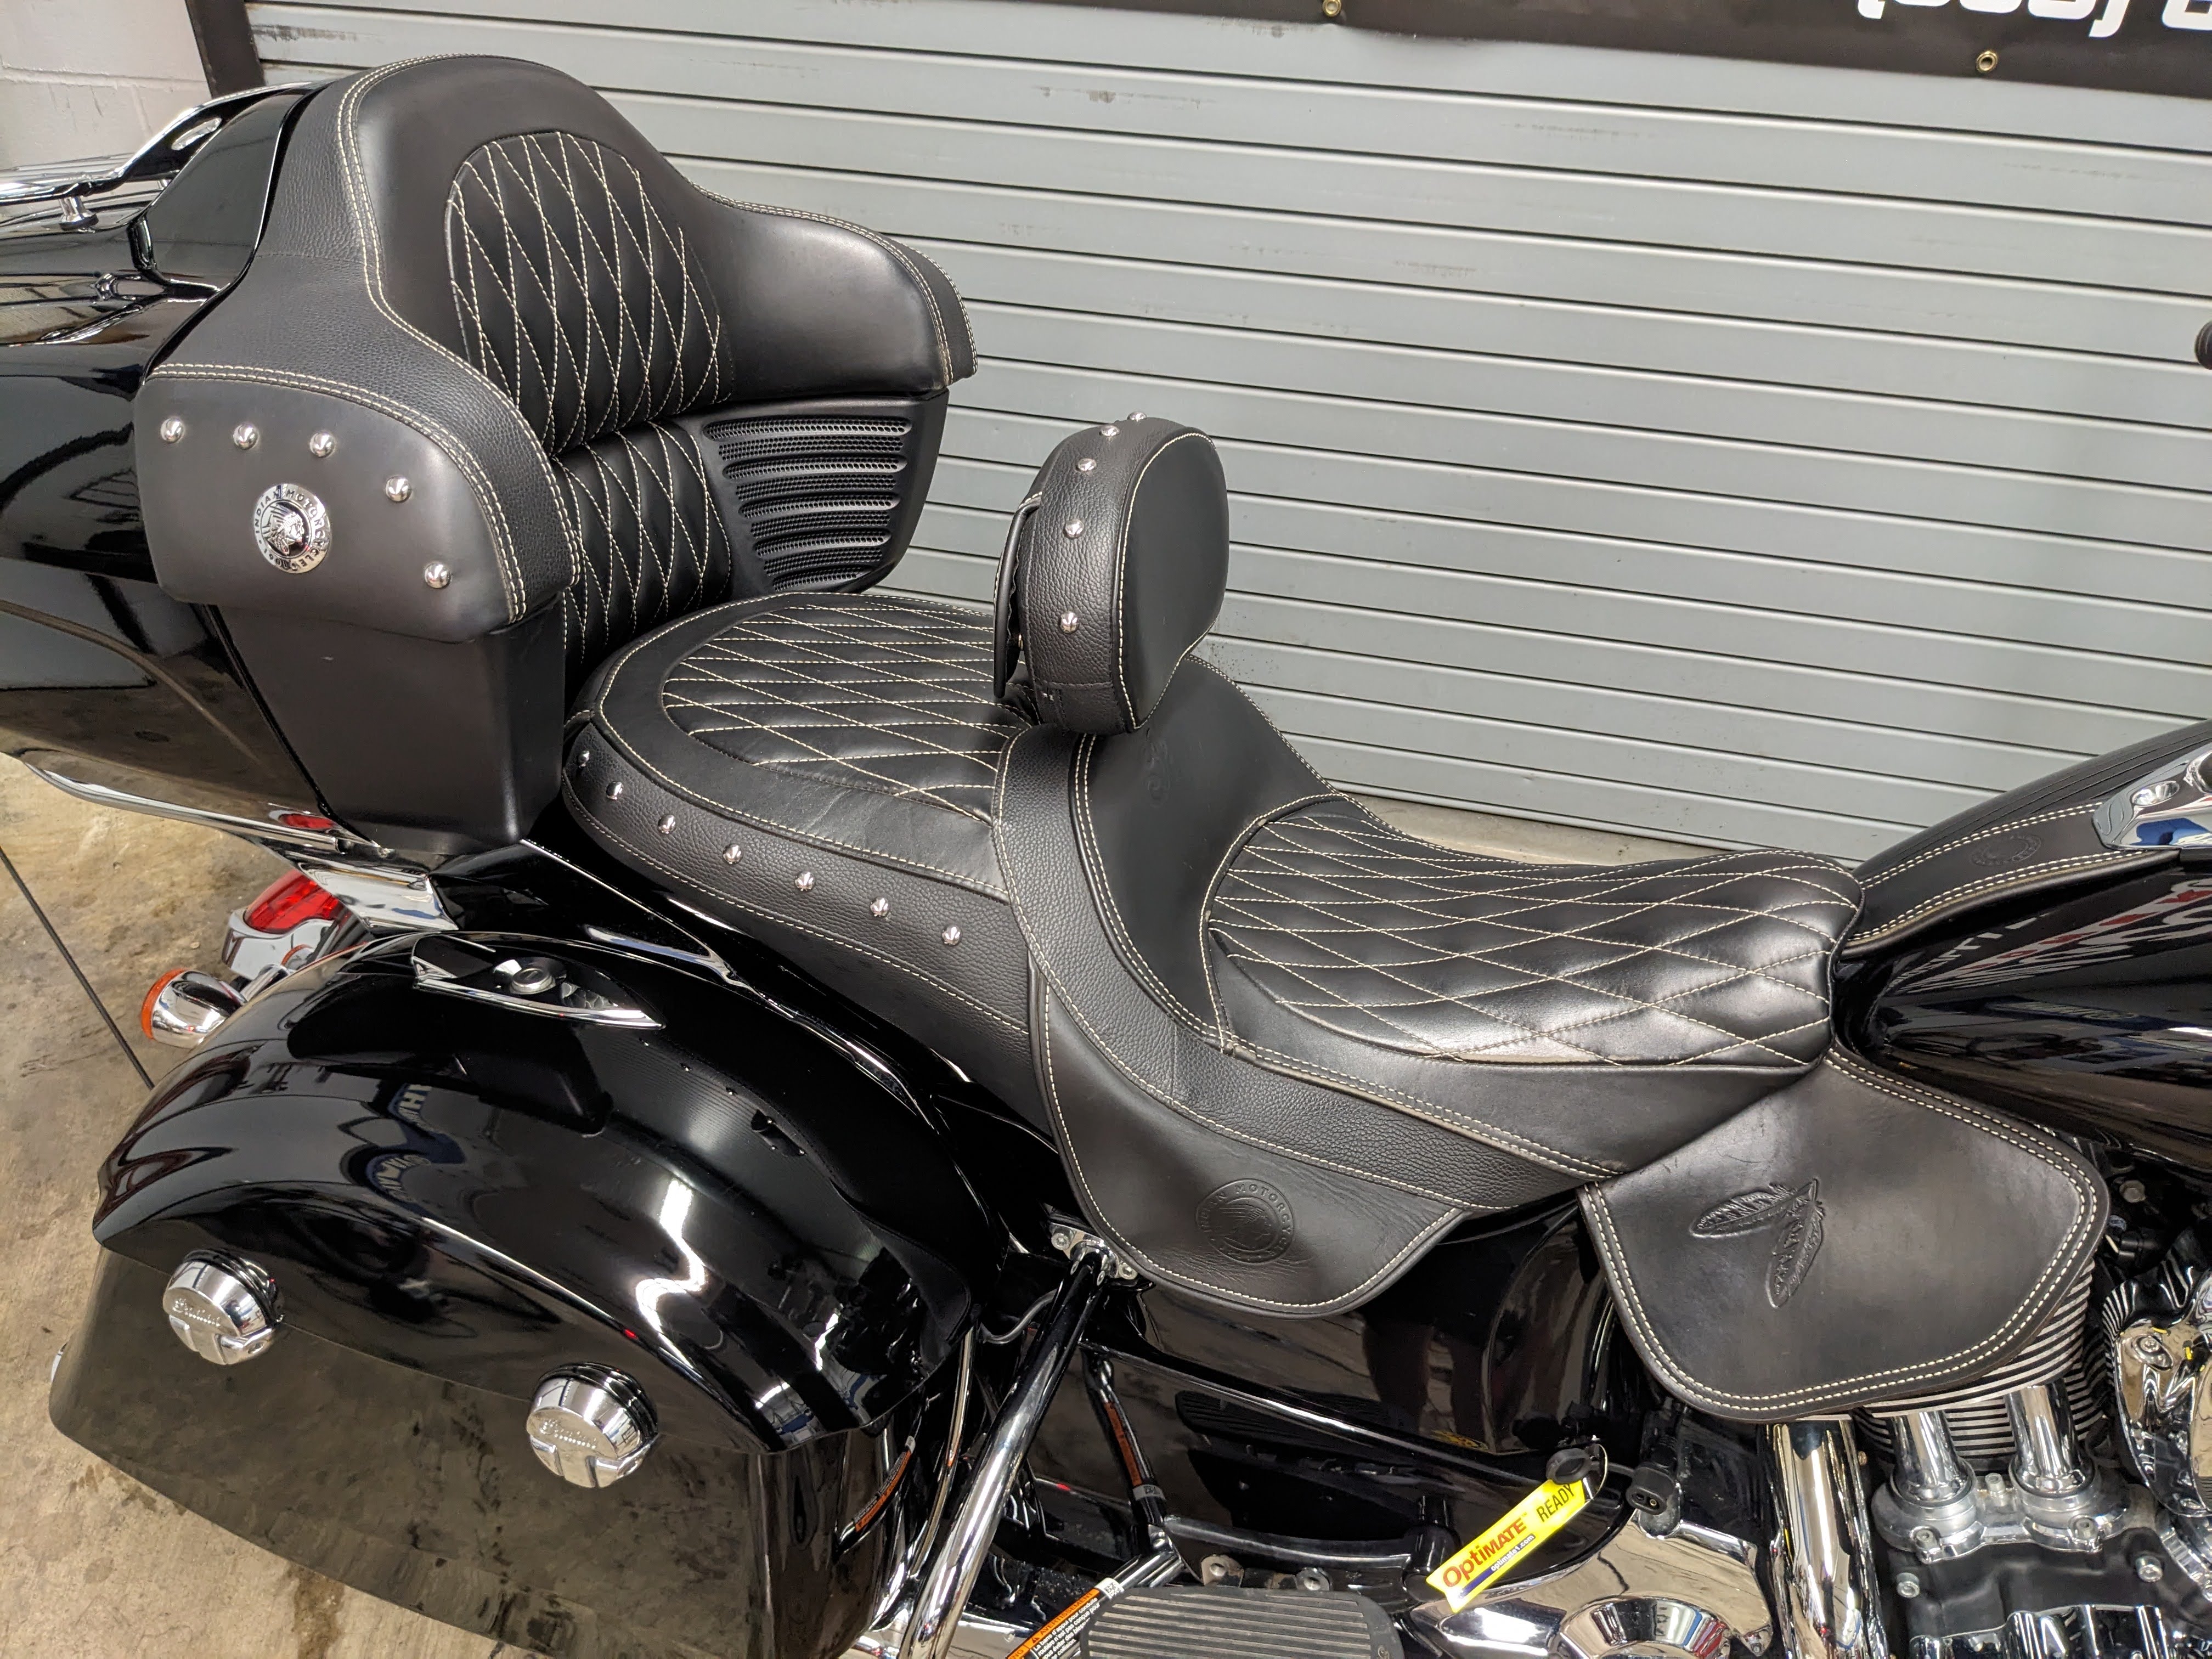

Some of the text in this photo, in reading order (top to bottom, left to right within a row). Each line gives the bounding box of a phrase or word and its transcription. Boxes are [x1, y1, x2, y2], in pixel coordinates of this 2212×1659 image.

[1537, 1483, 1575, 1522] READY
[1491, 1534, 1534, 1571] optimate1.com
[1040, 1593, 1093, 1635] AVERTISSEMENT
[1065, 1623, 1075, 1633] pas
[1068, 1611, 1079, 1623] pour
[1079, 1597, 1098, 1613] conduite
